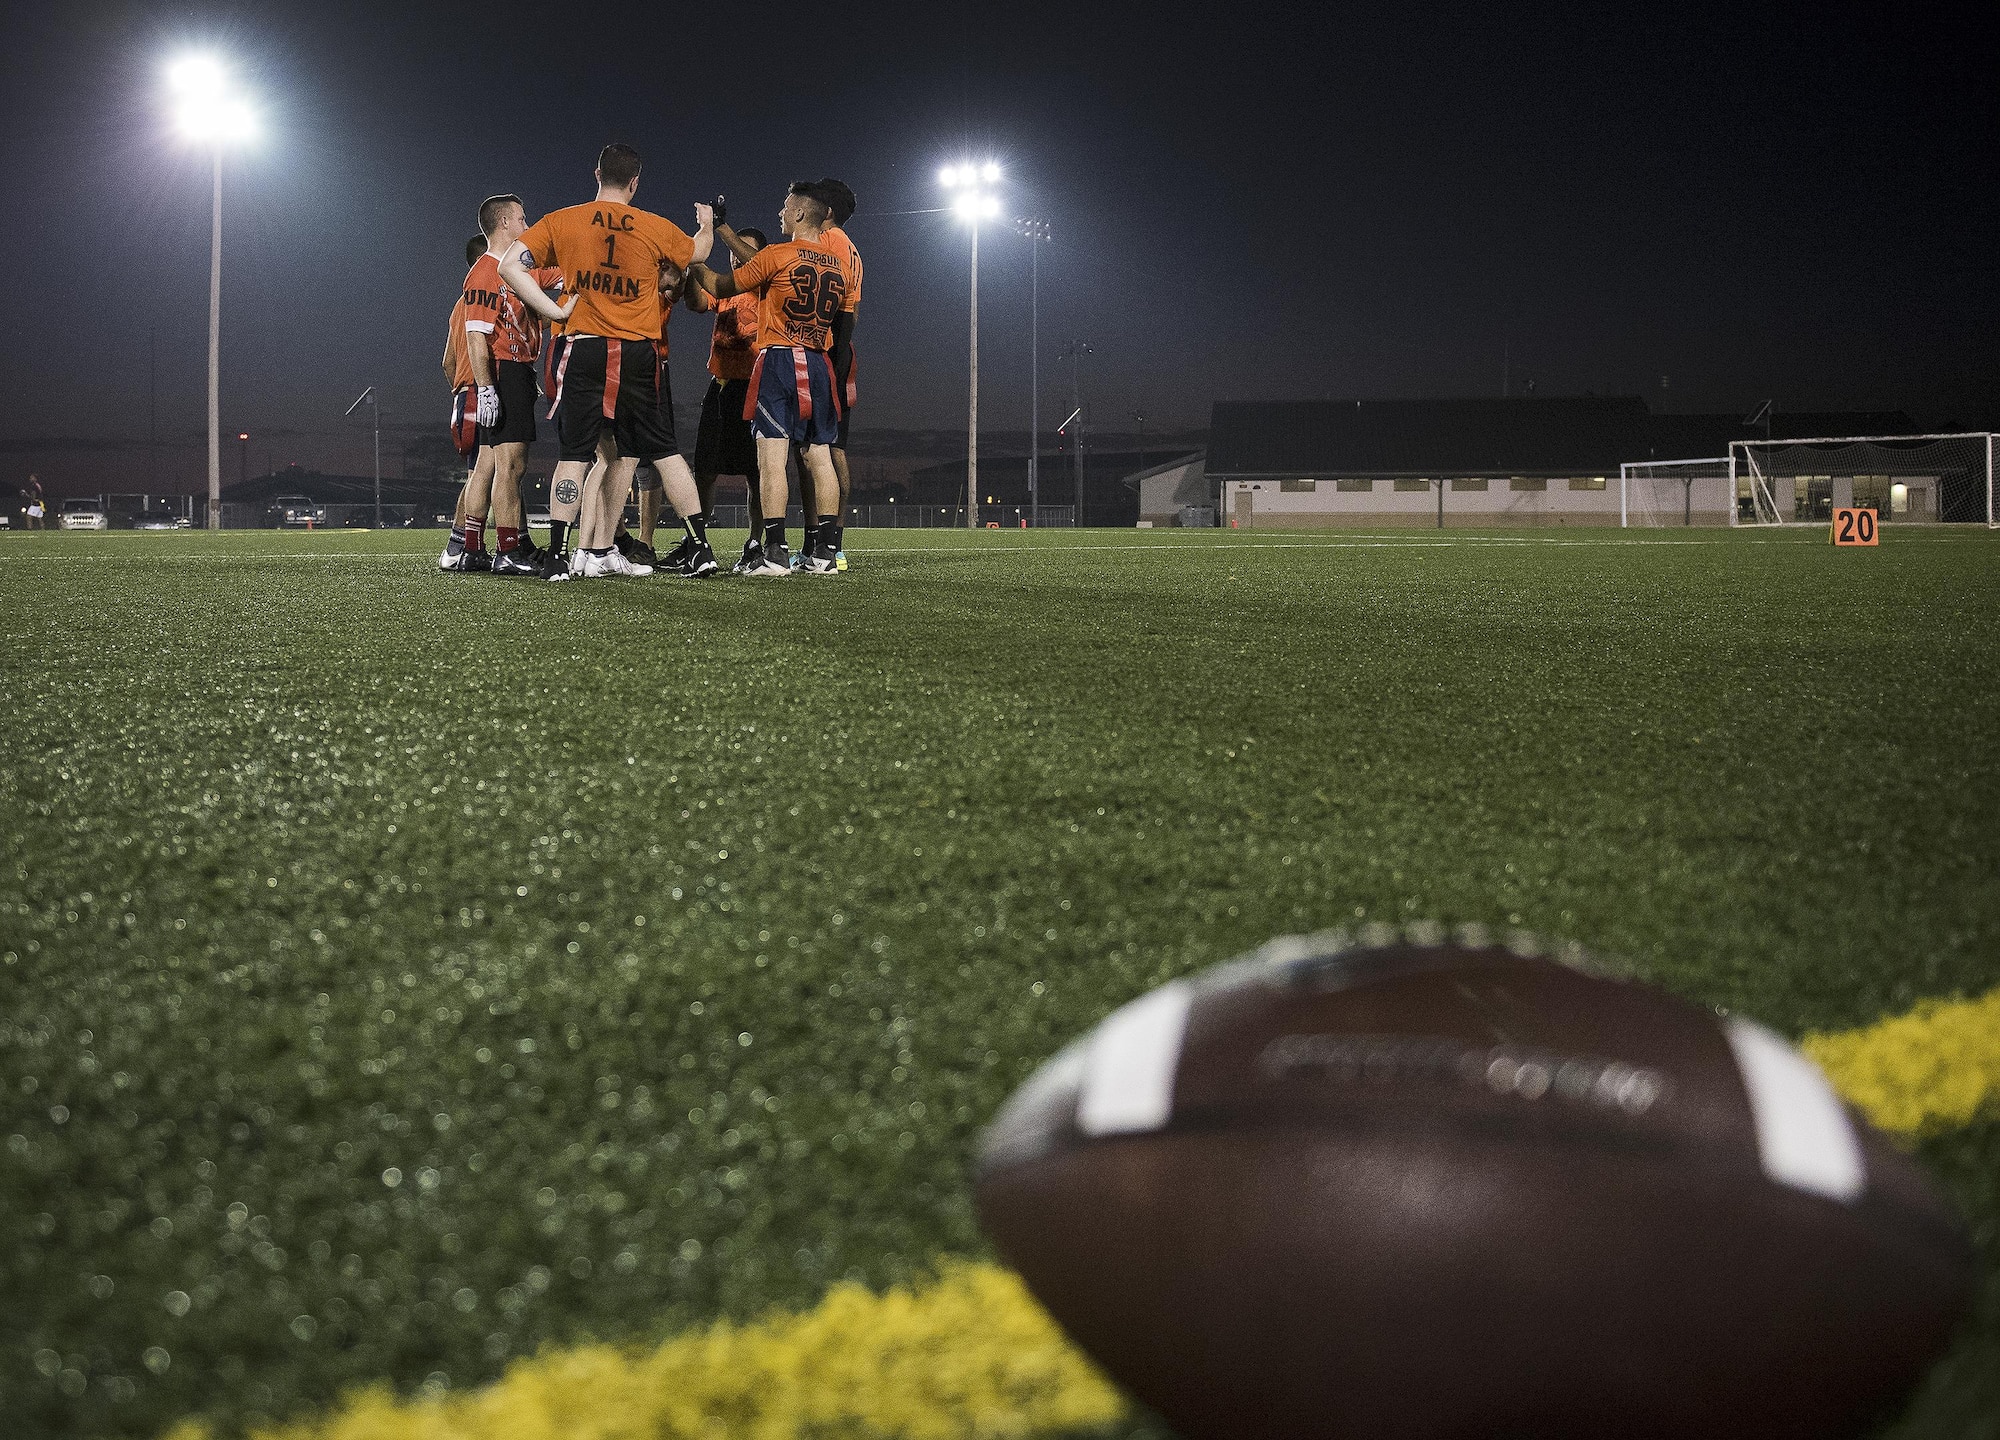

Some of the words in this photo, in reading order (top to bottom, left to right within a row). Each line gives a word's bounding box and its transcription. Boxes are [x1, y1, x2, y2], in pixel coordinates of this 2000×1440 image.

[591, 210, 635, 231] ALC
[600, 233, 620, 269] 1
[575, 270, 640, 297] MORAN
[782, 264, 845, 328] 36
[1838, 511, 1874, 542] 20
